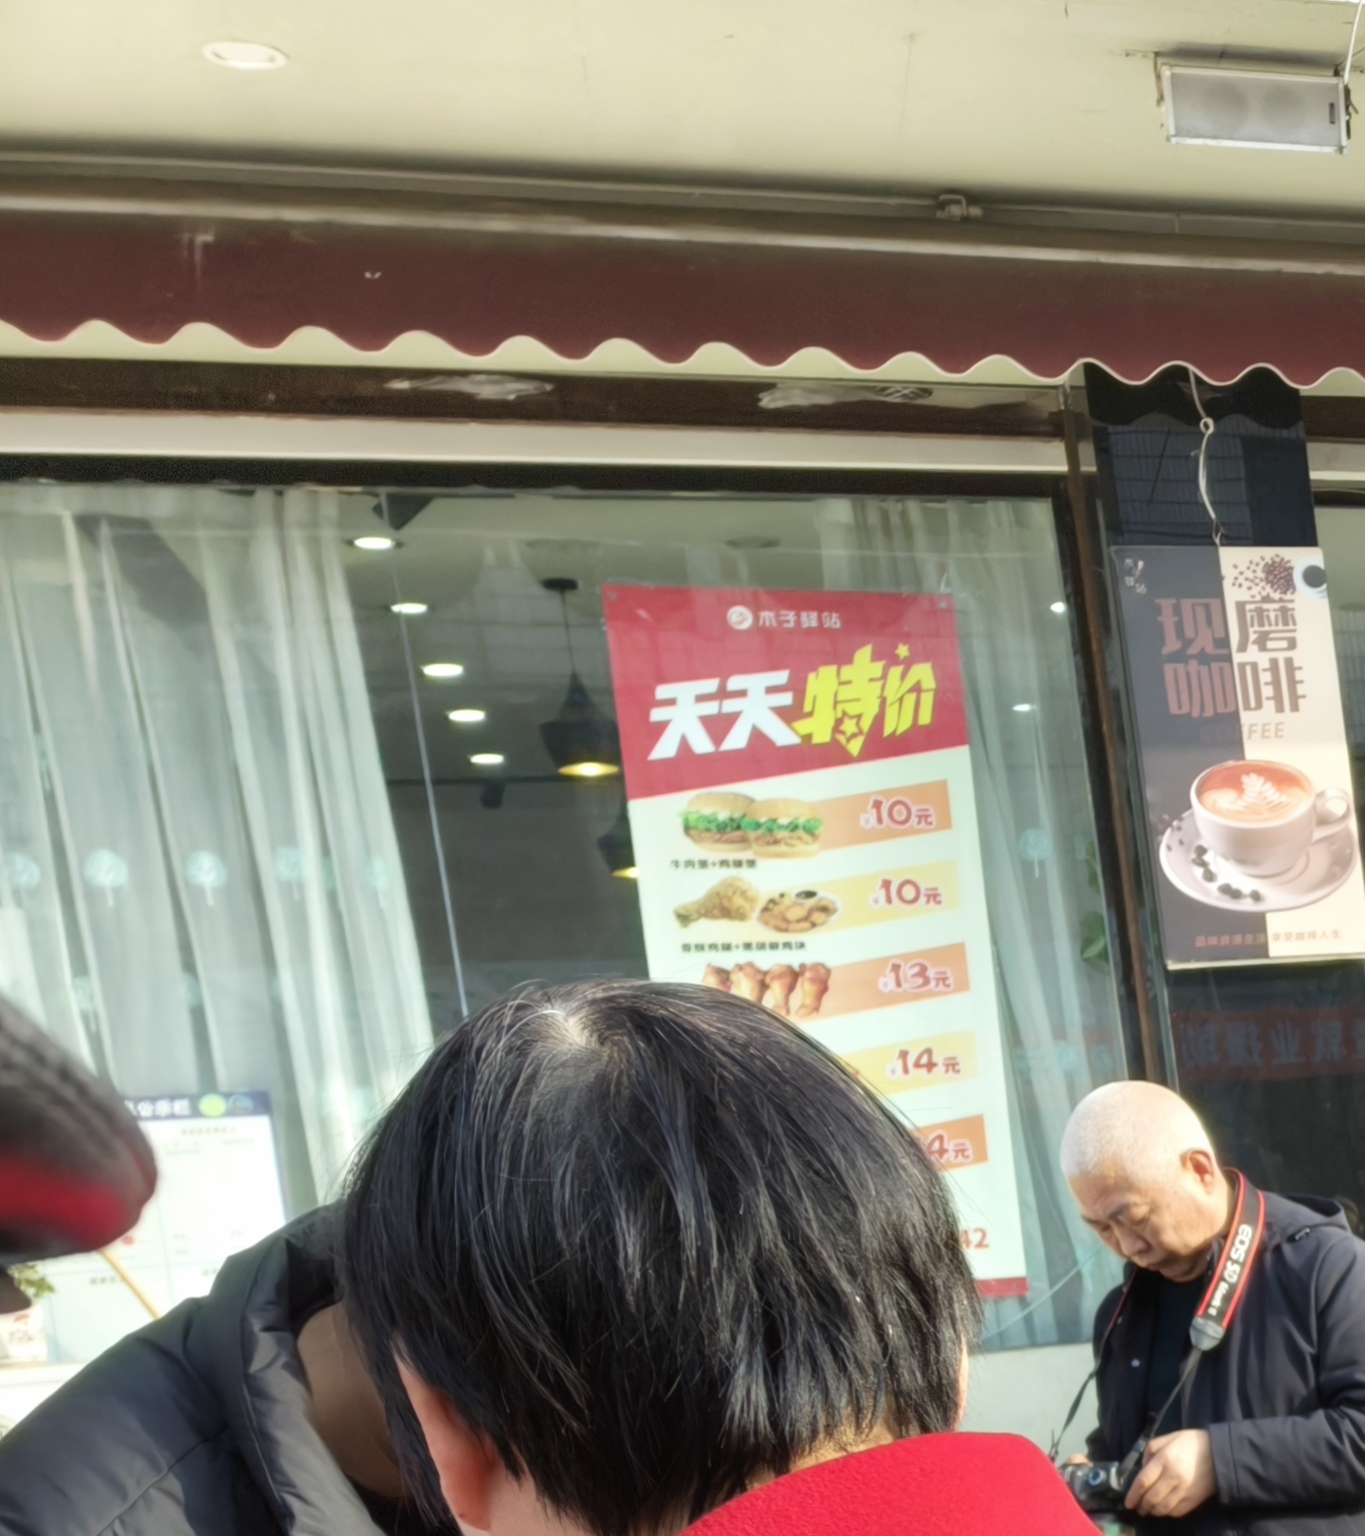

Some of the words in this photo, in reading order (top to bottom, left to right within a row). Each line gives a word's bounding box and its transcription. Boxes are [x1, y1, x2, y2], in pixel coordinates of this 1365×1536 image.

[758, 609, 841, 628] 木子驿站
[1155, 596, 1298, 655] 现磨
[647, 643, 937, 758] 天天特价
[1162, 657, 1307, 718] 咖啡
[1230, 1223, 1253, 1264] EOS
[1223, 1260, 1241, 1284] 5D
